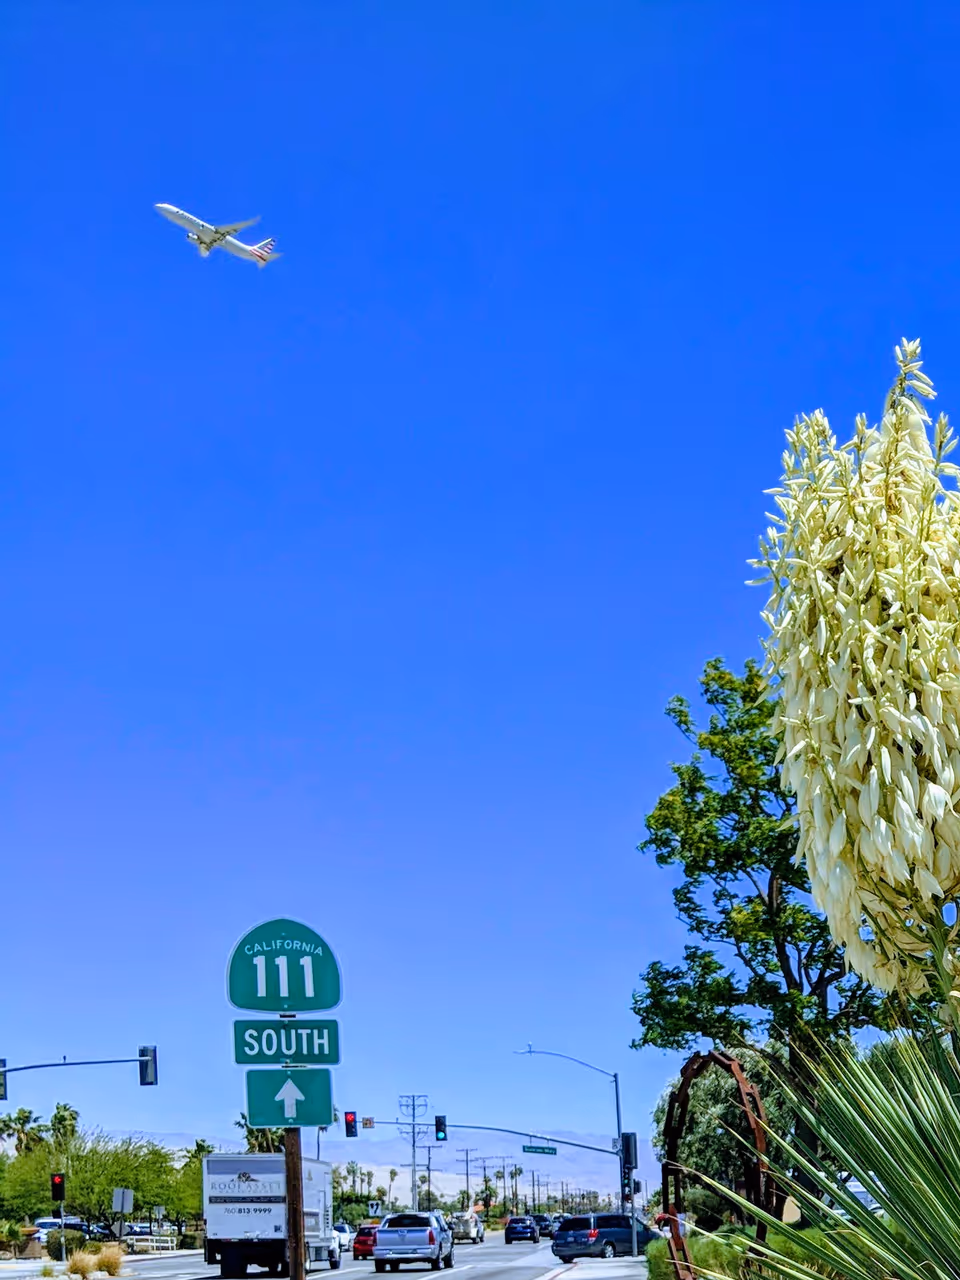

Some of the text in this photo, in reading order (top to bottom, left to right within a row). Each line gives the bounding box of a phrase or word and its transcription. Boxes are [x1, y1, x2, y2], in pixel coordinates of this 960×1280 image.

[244, 940, 323, 956] CALIFORNIA
[253, 955, 314, 997] 111
[244, 1029, 329, 1056] SOUTH
